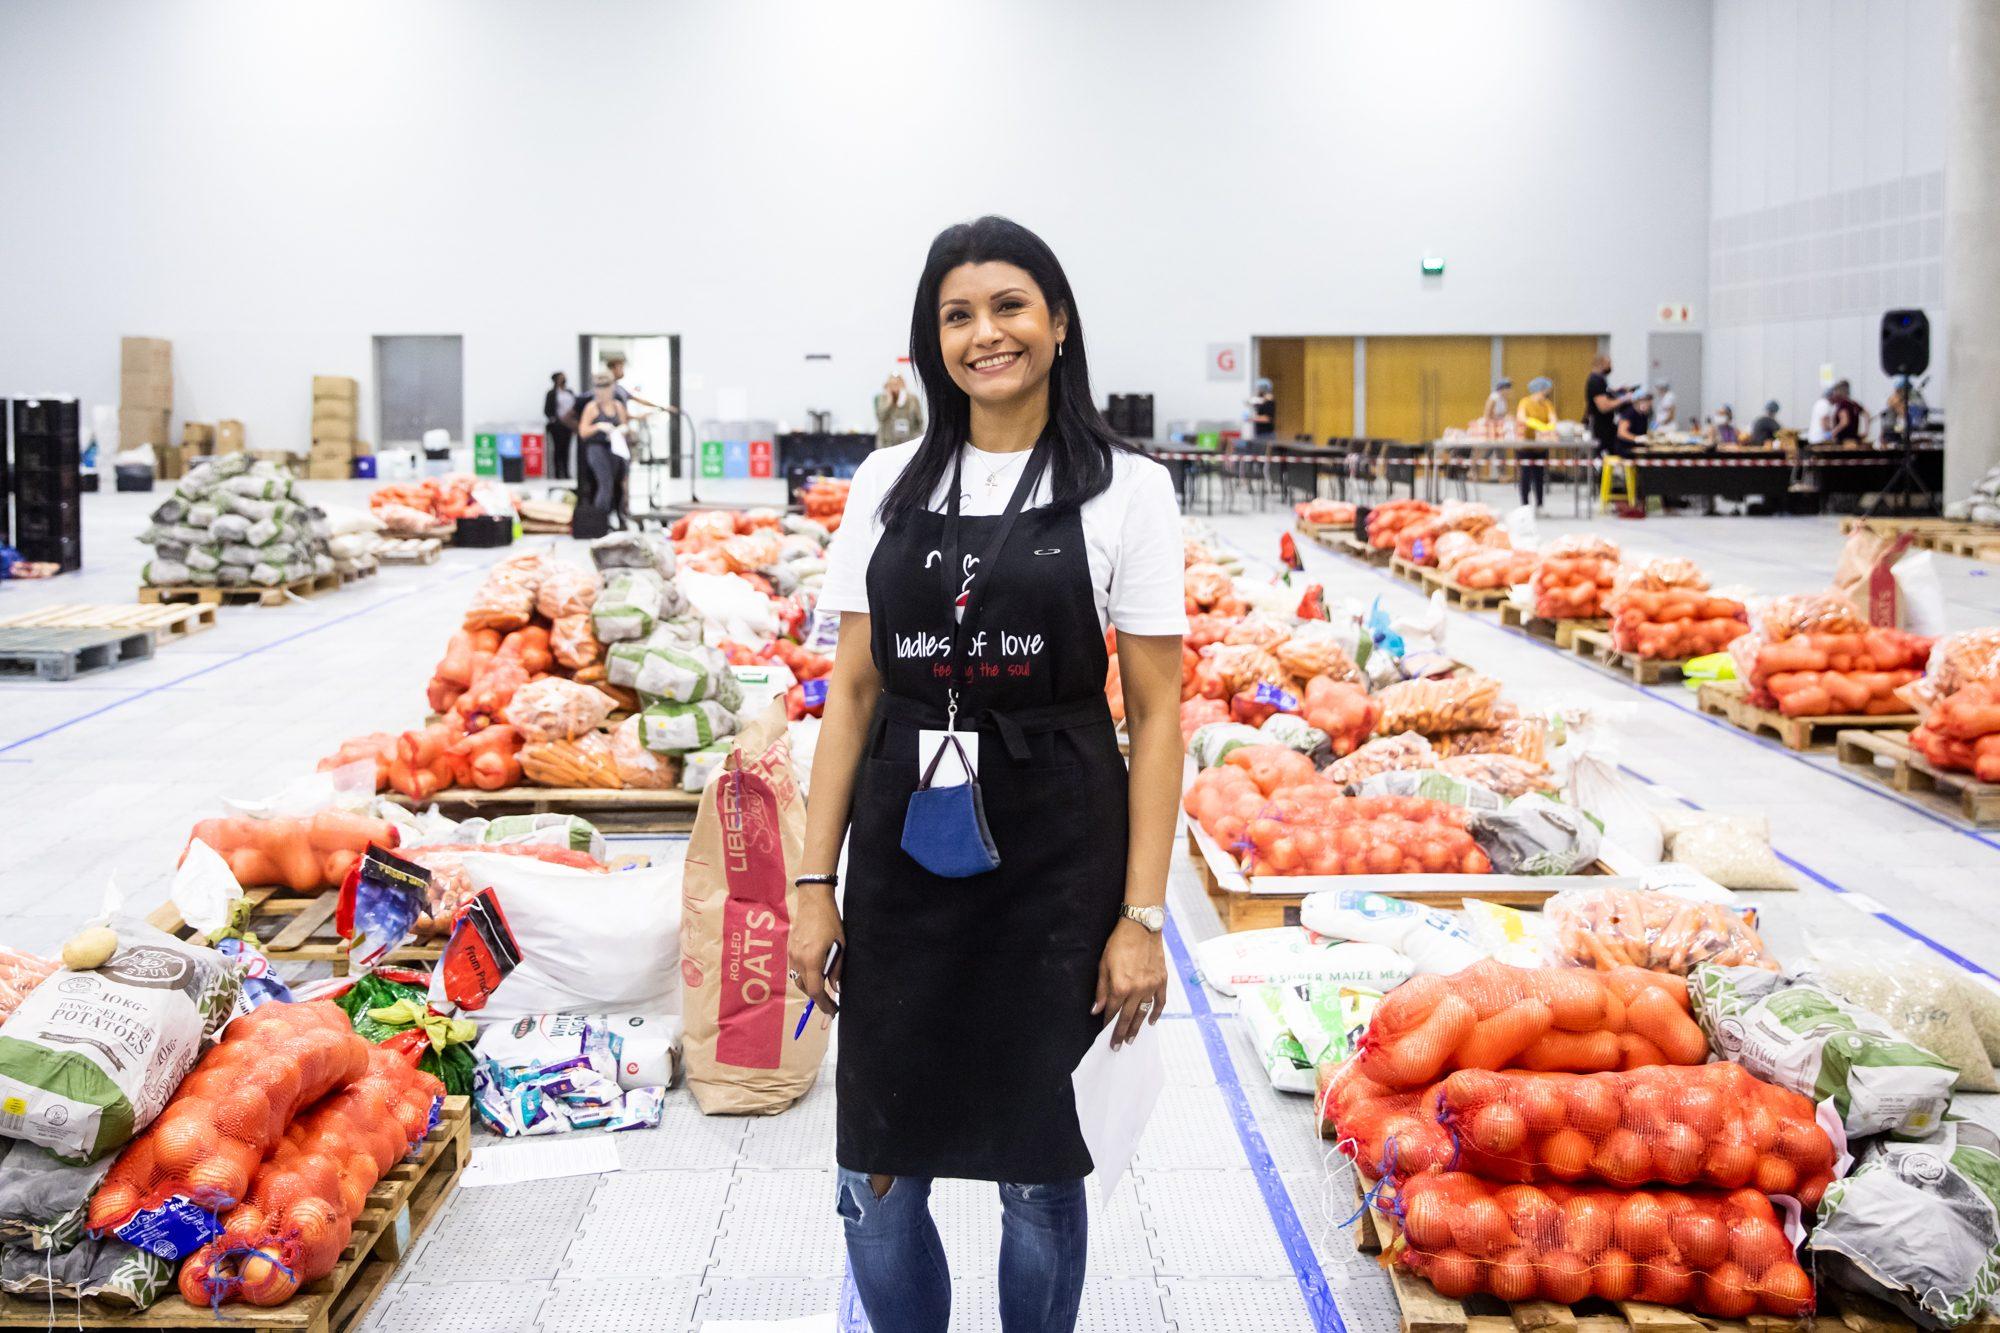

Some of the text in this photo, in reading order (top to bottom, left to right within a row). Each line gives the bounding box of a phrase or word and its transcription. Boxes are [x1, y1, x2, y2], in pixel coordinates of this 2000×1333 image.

[1216, 349, 1236, 372] G
[895, 631, 951, 659] ladles
[1001, 630, 1044, 657] love
[979, 661, 1000, 677] the
[1007, 661, 1031, 677] soul
[465, 945, 481, 971] From
[729, 931, 742, 982] ROLLED
[741, 910, 776, 1005] OATS
[1329, 971, 1373, 982] MAIZE
[50, 1008, 149, 1056] POTATOES
